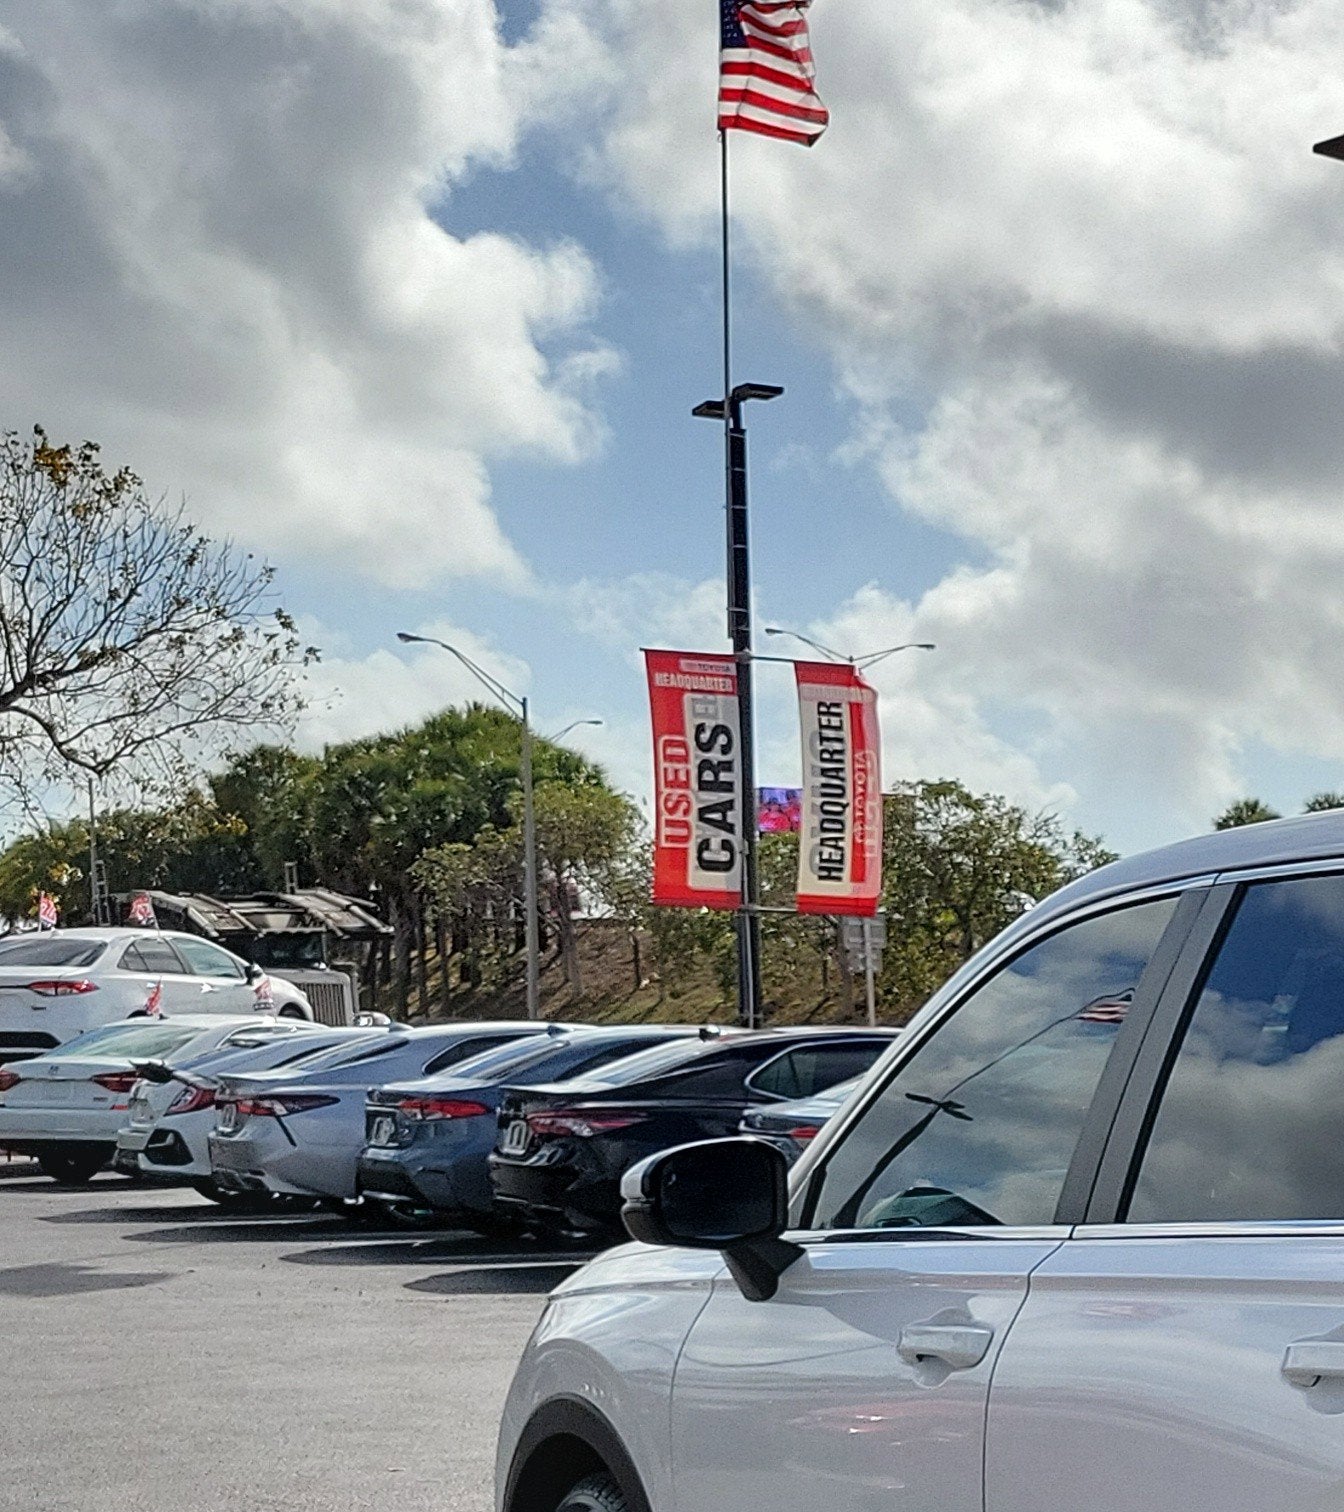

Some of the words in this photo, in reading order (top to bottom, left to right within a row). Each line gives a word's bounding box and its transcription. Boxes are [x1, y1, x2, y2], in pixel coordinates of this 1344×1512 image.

[660, 734, 694, 848] USED
[694, 722, 736, 873] CARS
[817, 701, 850, 881] HEADQUARTER
